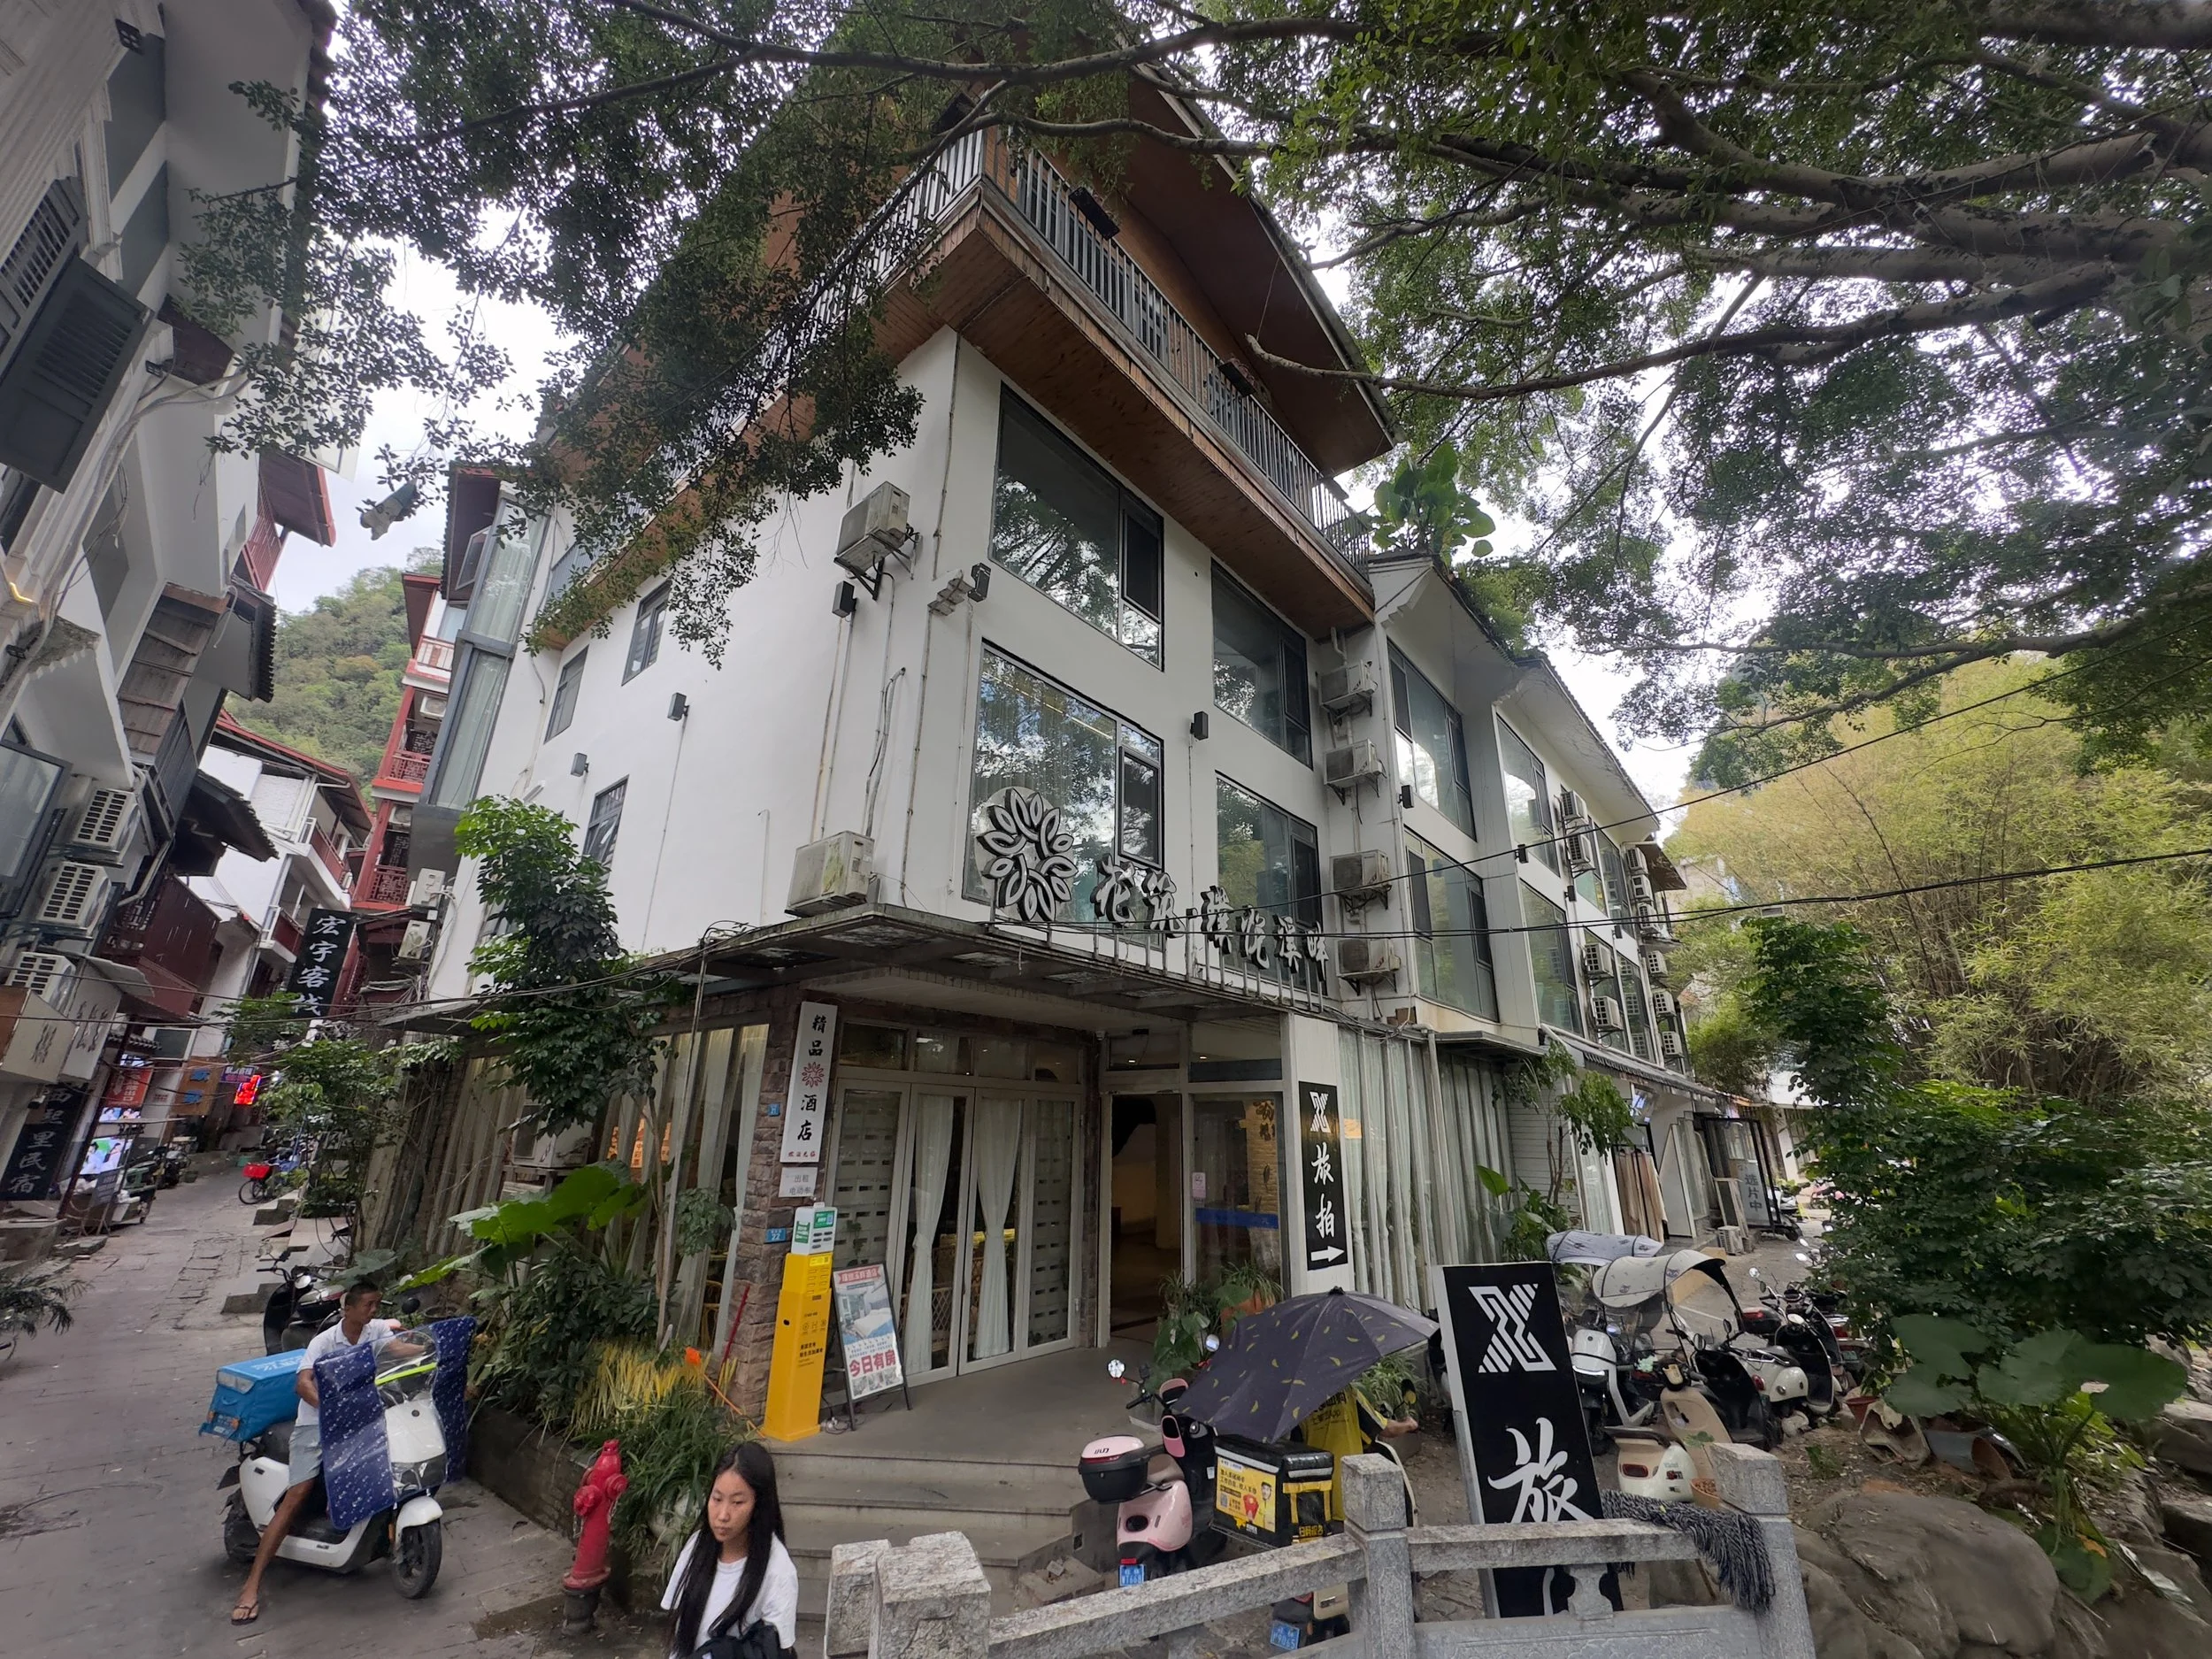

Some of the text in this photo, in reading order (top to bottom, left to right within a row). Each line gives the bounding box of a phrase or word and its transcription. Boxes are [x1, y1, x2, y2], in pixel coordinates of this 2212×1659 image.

[797, 1014, 827, 1141] 精品酒店
[1310, 1141, 1334, 1240] 旅拍
[1744, 1173, 1763, 1212] 选片中
[849, 1349, 895, 1378] 今日有房
